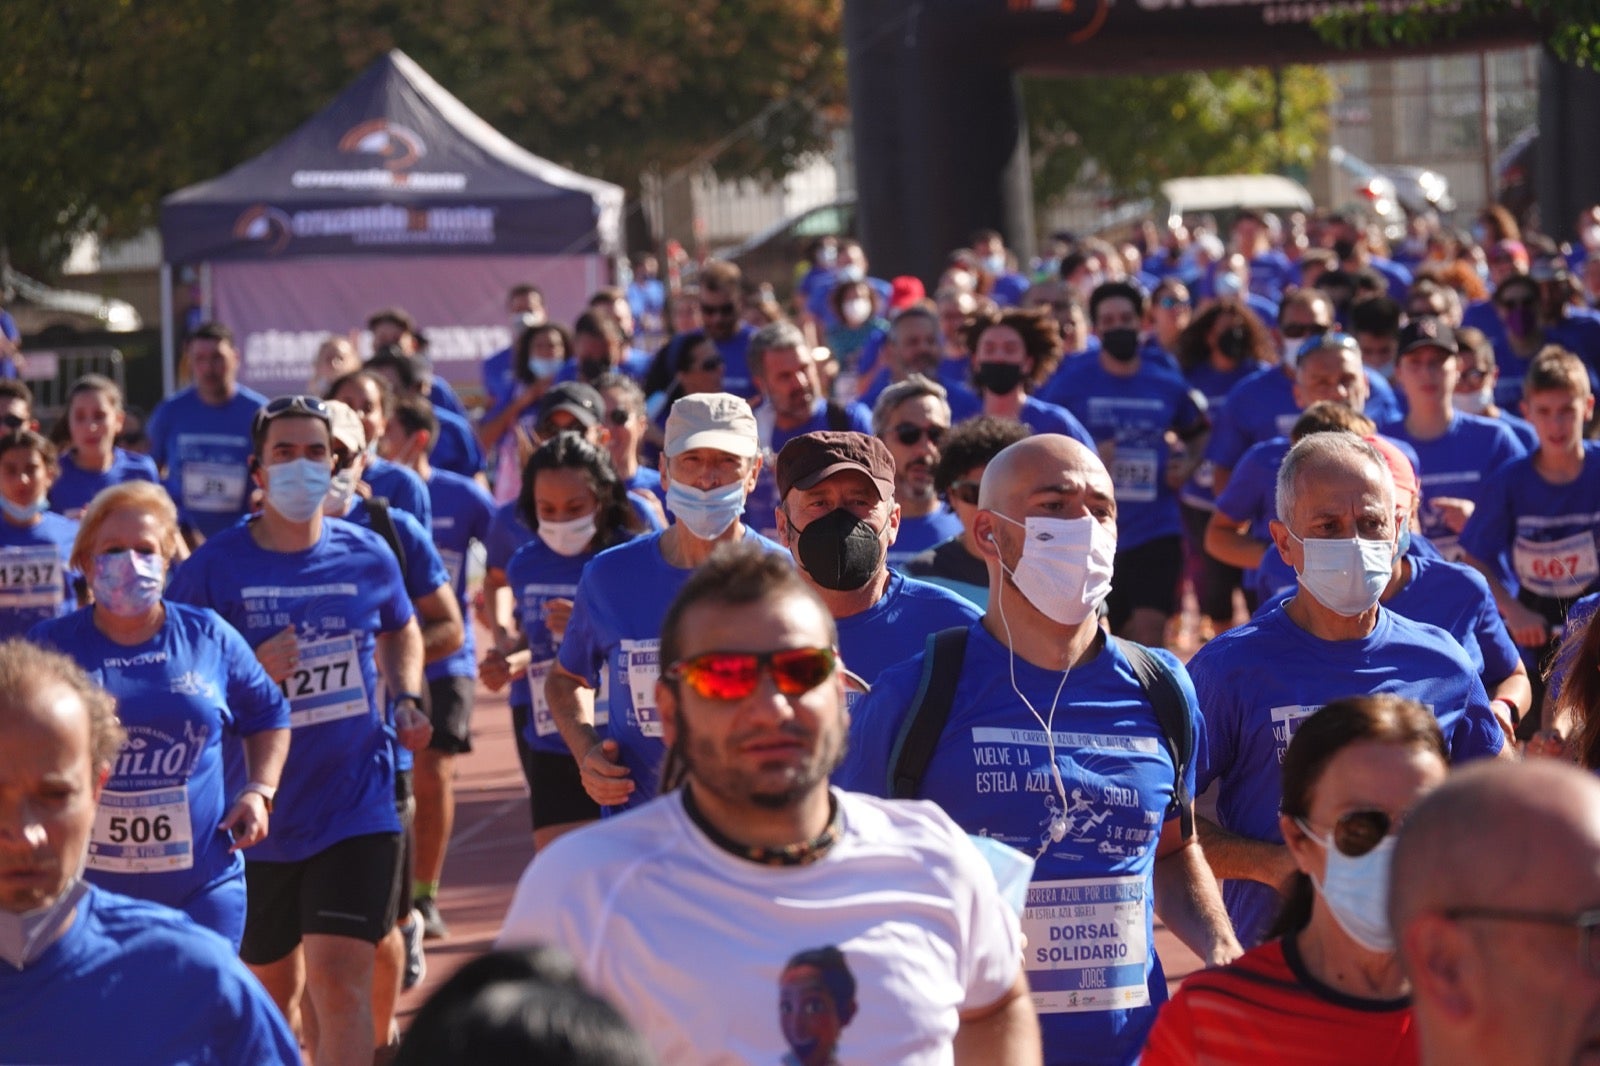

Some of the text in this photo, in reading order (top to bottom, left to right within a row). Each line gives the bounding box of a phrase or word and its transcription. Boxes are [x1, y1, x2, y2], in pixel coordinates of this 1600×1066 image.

[0, 563, 54, 586] 1237
[1532, 554, 1579, 579] 667
[1023, 731, 1052, 745] CARRER
[1057, 733, 1074, 745] AZUL
[1078, 735, 1091, 747] POR
[973, 747, 1031, 767] VUELVE LA
[976, 771, 1051, 793] ESTELA AZUL
[109, 814, 172, 843] 506
[1061, 886, 1081, 902] AZUL
[1085, 885, 1100, 900] POR
[1103, 884, 1112, 899] EL
[1036, 908, 1056, 920] ESTELA
[1049, 923, 1119, 941] DORSAL
[1036, 943, 1128, 962] SOLIDARIO
[1079, 968, 1107, 989] JORGE
